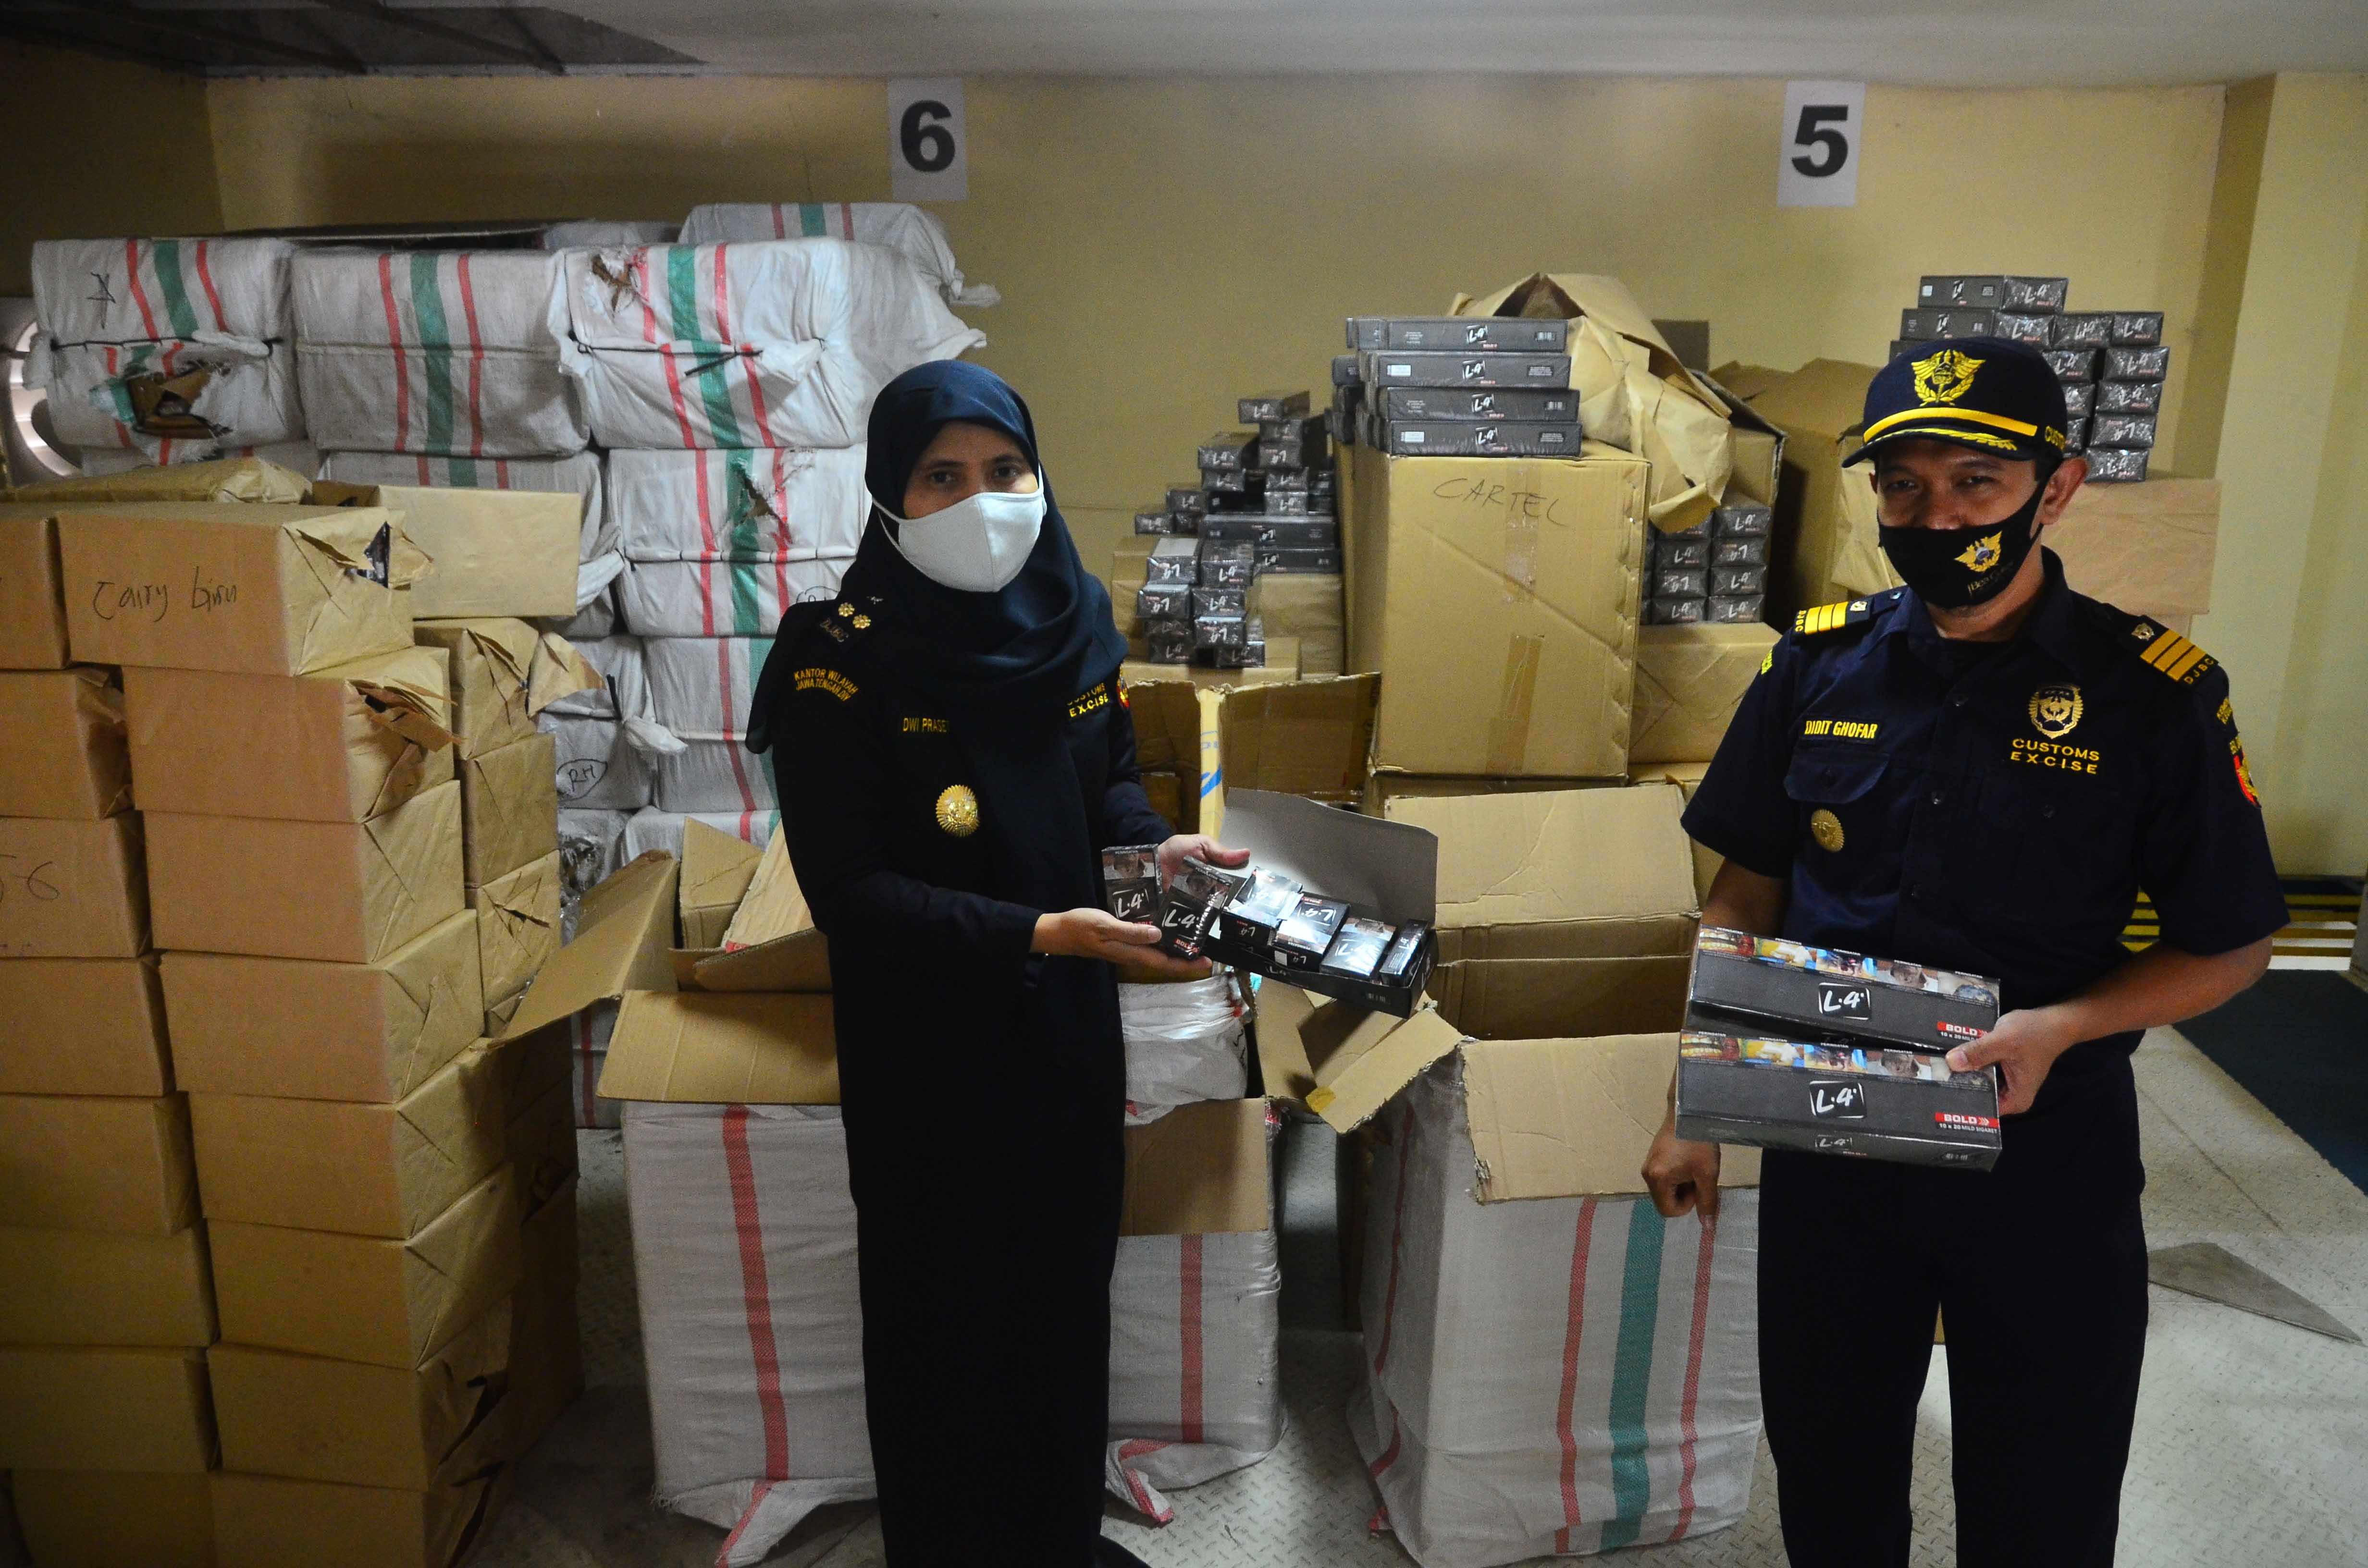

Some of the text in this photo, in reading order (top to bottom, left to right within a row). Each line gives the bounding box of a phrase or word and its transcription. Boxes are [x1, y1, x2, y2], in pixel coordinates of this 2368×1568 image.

[900, 100, 955, 172] 6
[1791, 105, 1849, 177] 5
[794, 668, 859, 695] KANTOR WILAYAH
[2183, 657, 2214, 685] DJBC
[796, 679, 814, 692] JAWA
[815, 678, 840, 695] TENGAH
[1069, 693, 1109, 717] EXCISE
[902, 717, 919, 732] DWI
[1804, 721, 1878, 738] DIDIT GHOFAR
[2012, 738, 2100, 761] CUSTOMS
[2011, 751, 2098, 774] EXCISE
[1946, 1024, 1978, 1036] BOLD
[1944, 1114, 1977, 1124] BOLD
